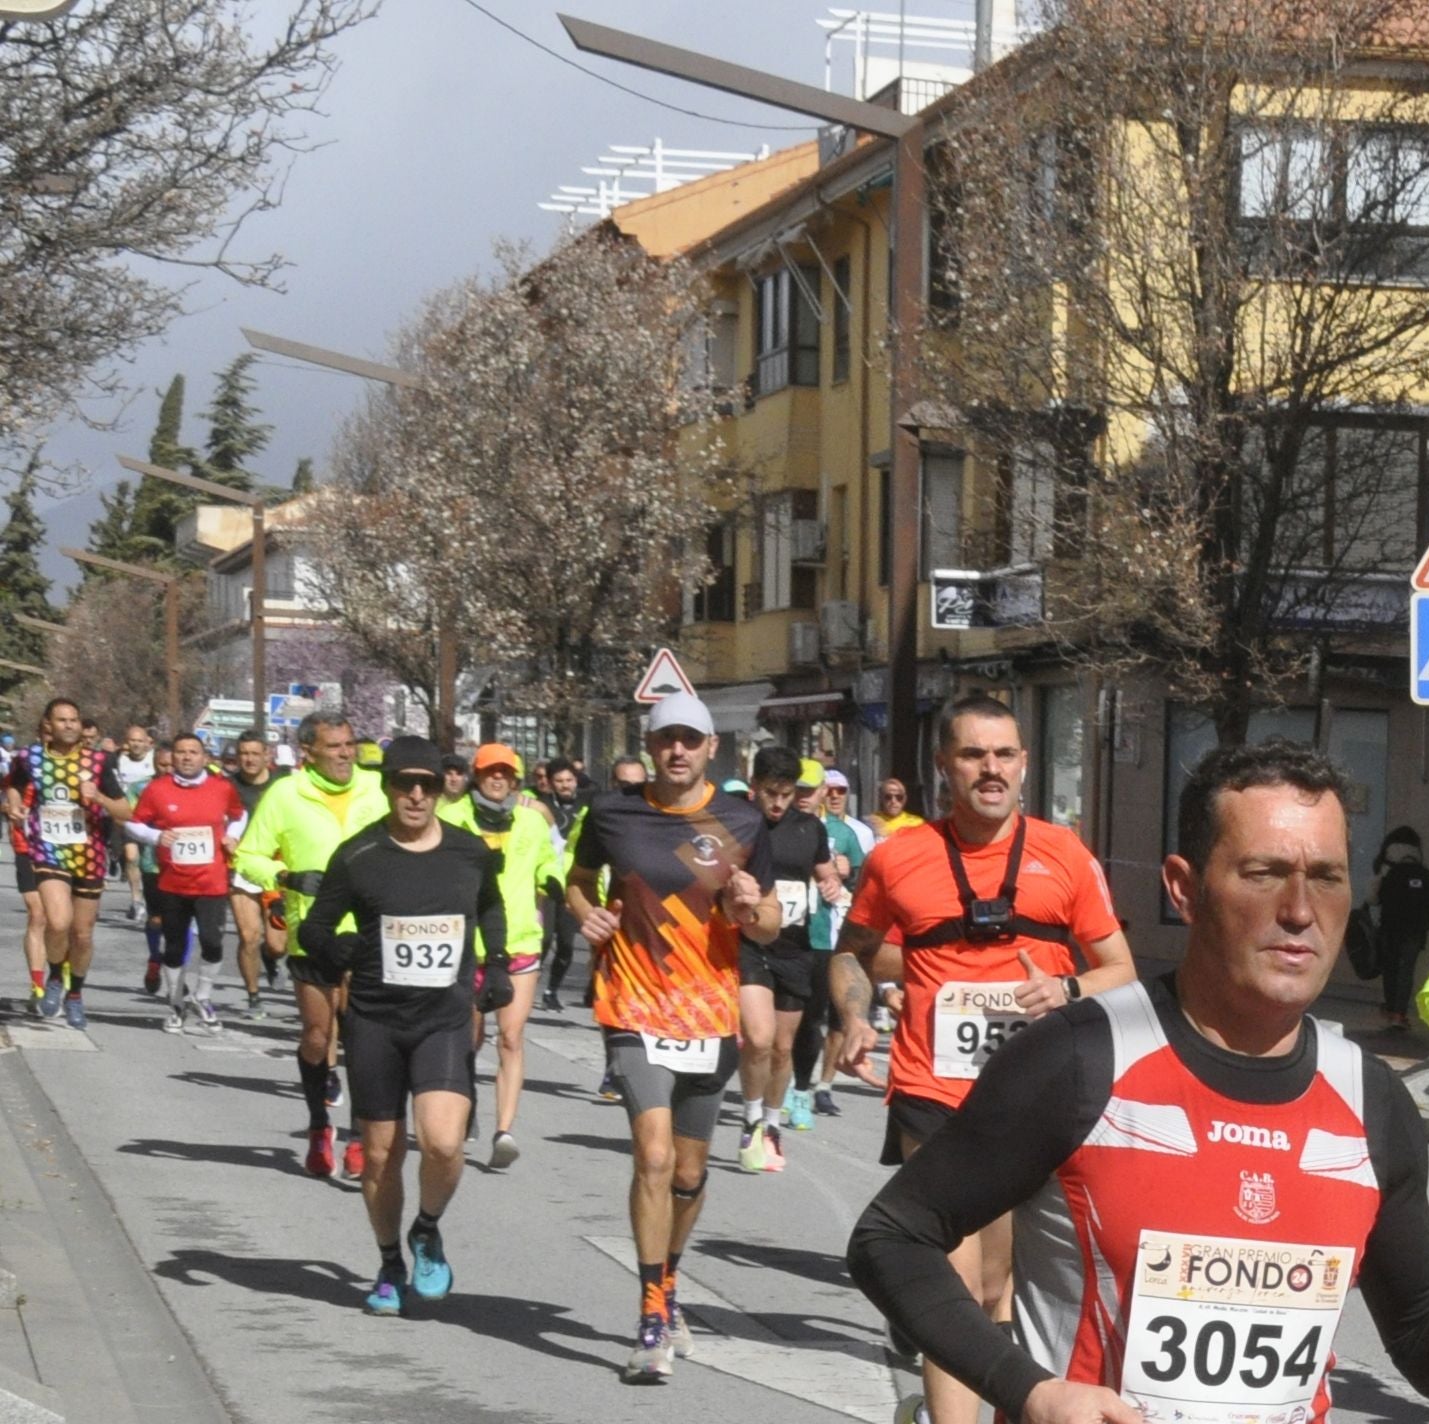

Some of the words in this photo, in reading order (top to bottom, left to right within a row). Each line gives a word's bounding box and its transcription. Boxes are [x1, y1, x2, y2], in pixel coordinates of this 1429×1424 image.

[176, 842, 206, 855] 791
[399, 923, 450, 935] FONDO
[395, 943, 454, 969] 932
[962, 993, 1014, 1008] FOND
[1191, 1244, 1234, 1260] GRAN
[1239, 1249, 1292, 1265] PREMIO
[1187, 1255, 1314, 1293] FONDO
[1141, 1315, 1322, 1390] 3054
